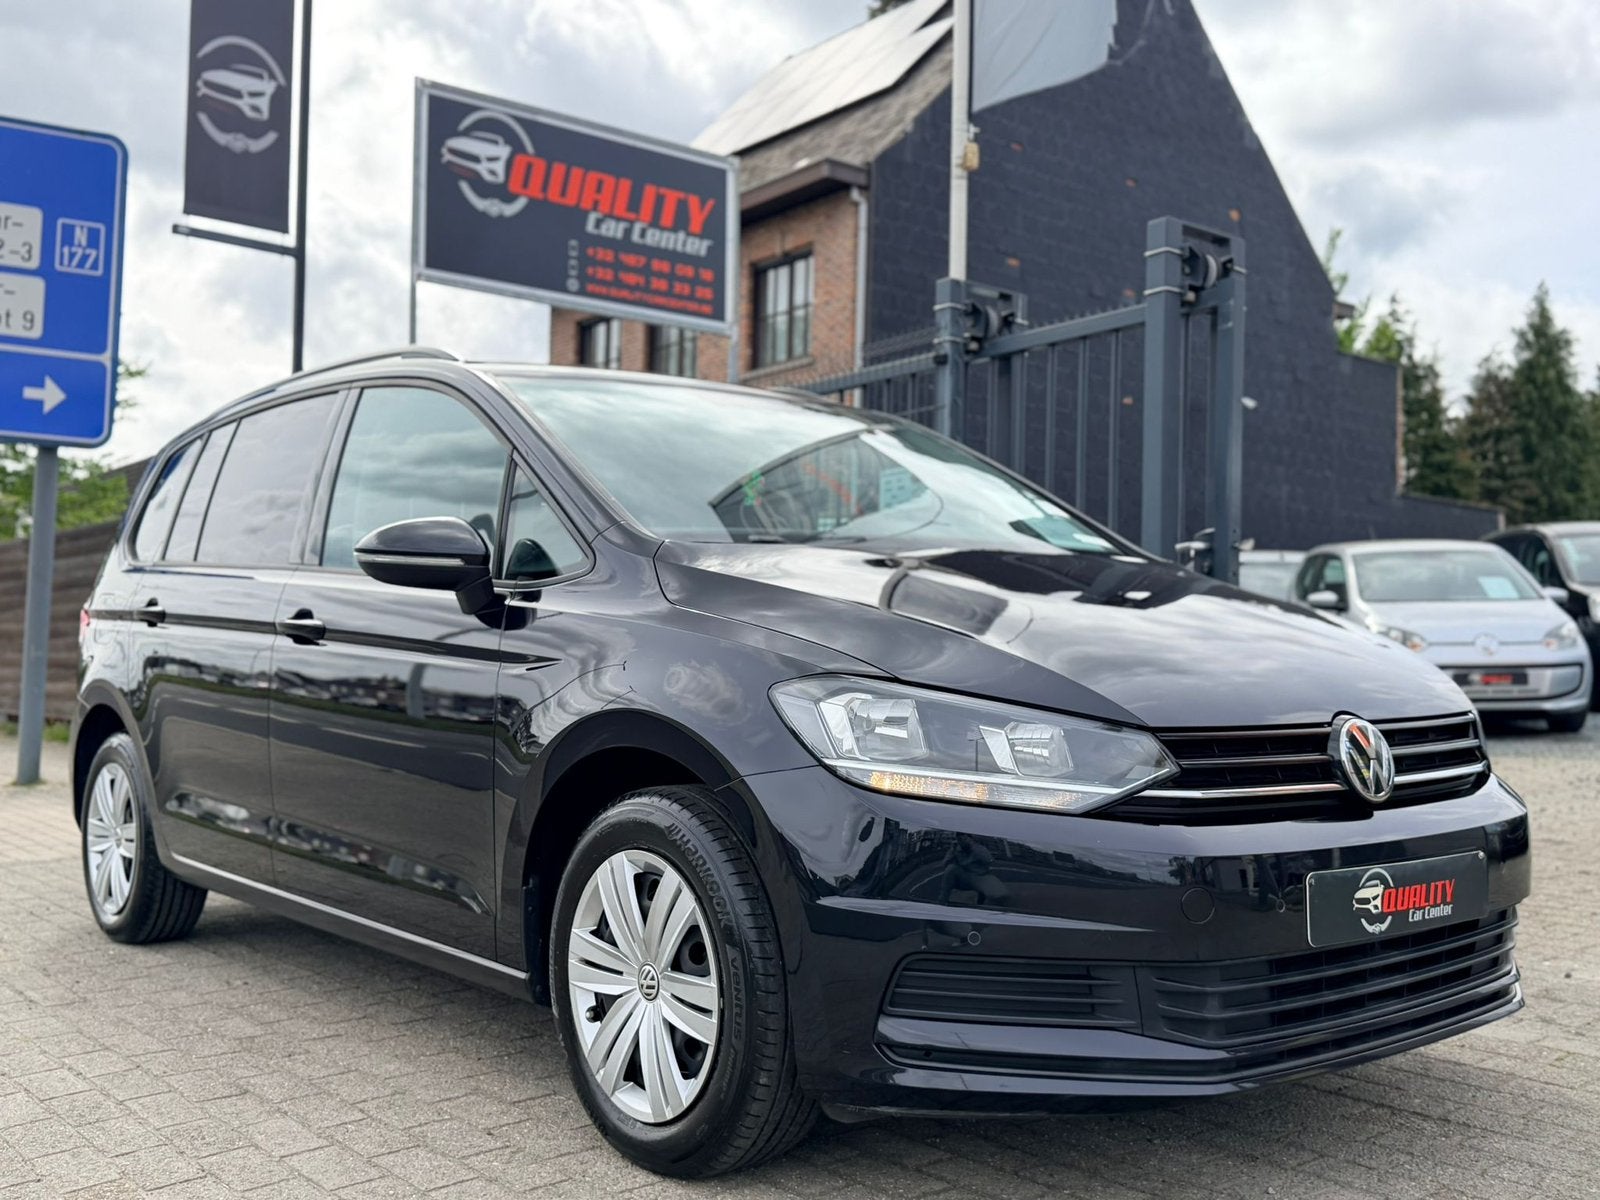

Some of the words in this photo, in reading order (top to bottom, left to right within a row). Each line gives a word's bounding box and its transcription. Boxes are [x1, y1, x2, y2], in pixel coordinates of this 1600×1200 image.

[508, 153, 715, 235] QUALITY
[74, 226, 88, 248] N
[585, 210, 631, 241] Car
[631, 221, 713, 258] Center
[62, 245, 98, 270] 177
[22, 310, 35, 331] 9
[1383, 879, 1456, 913] QUALITY
[1408, 909, 1424, 923] Car
[1424, 902, 1454, 920] Center
